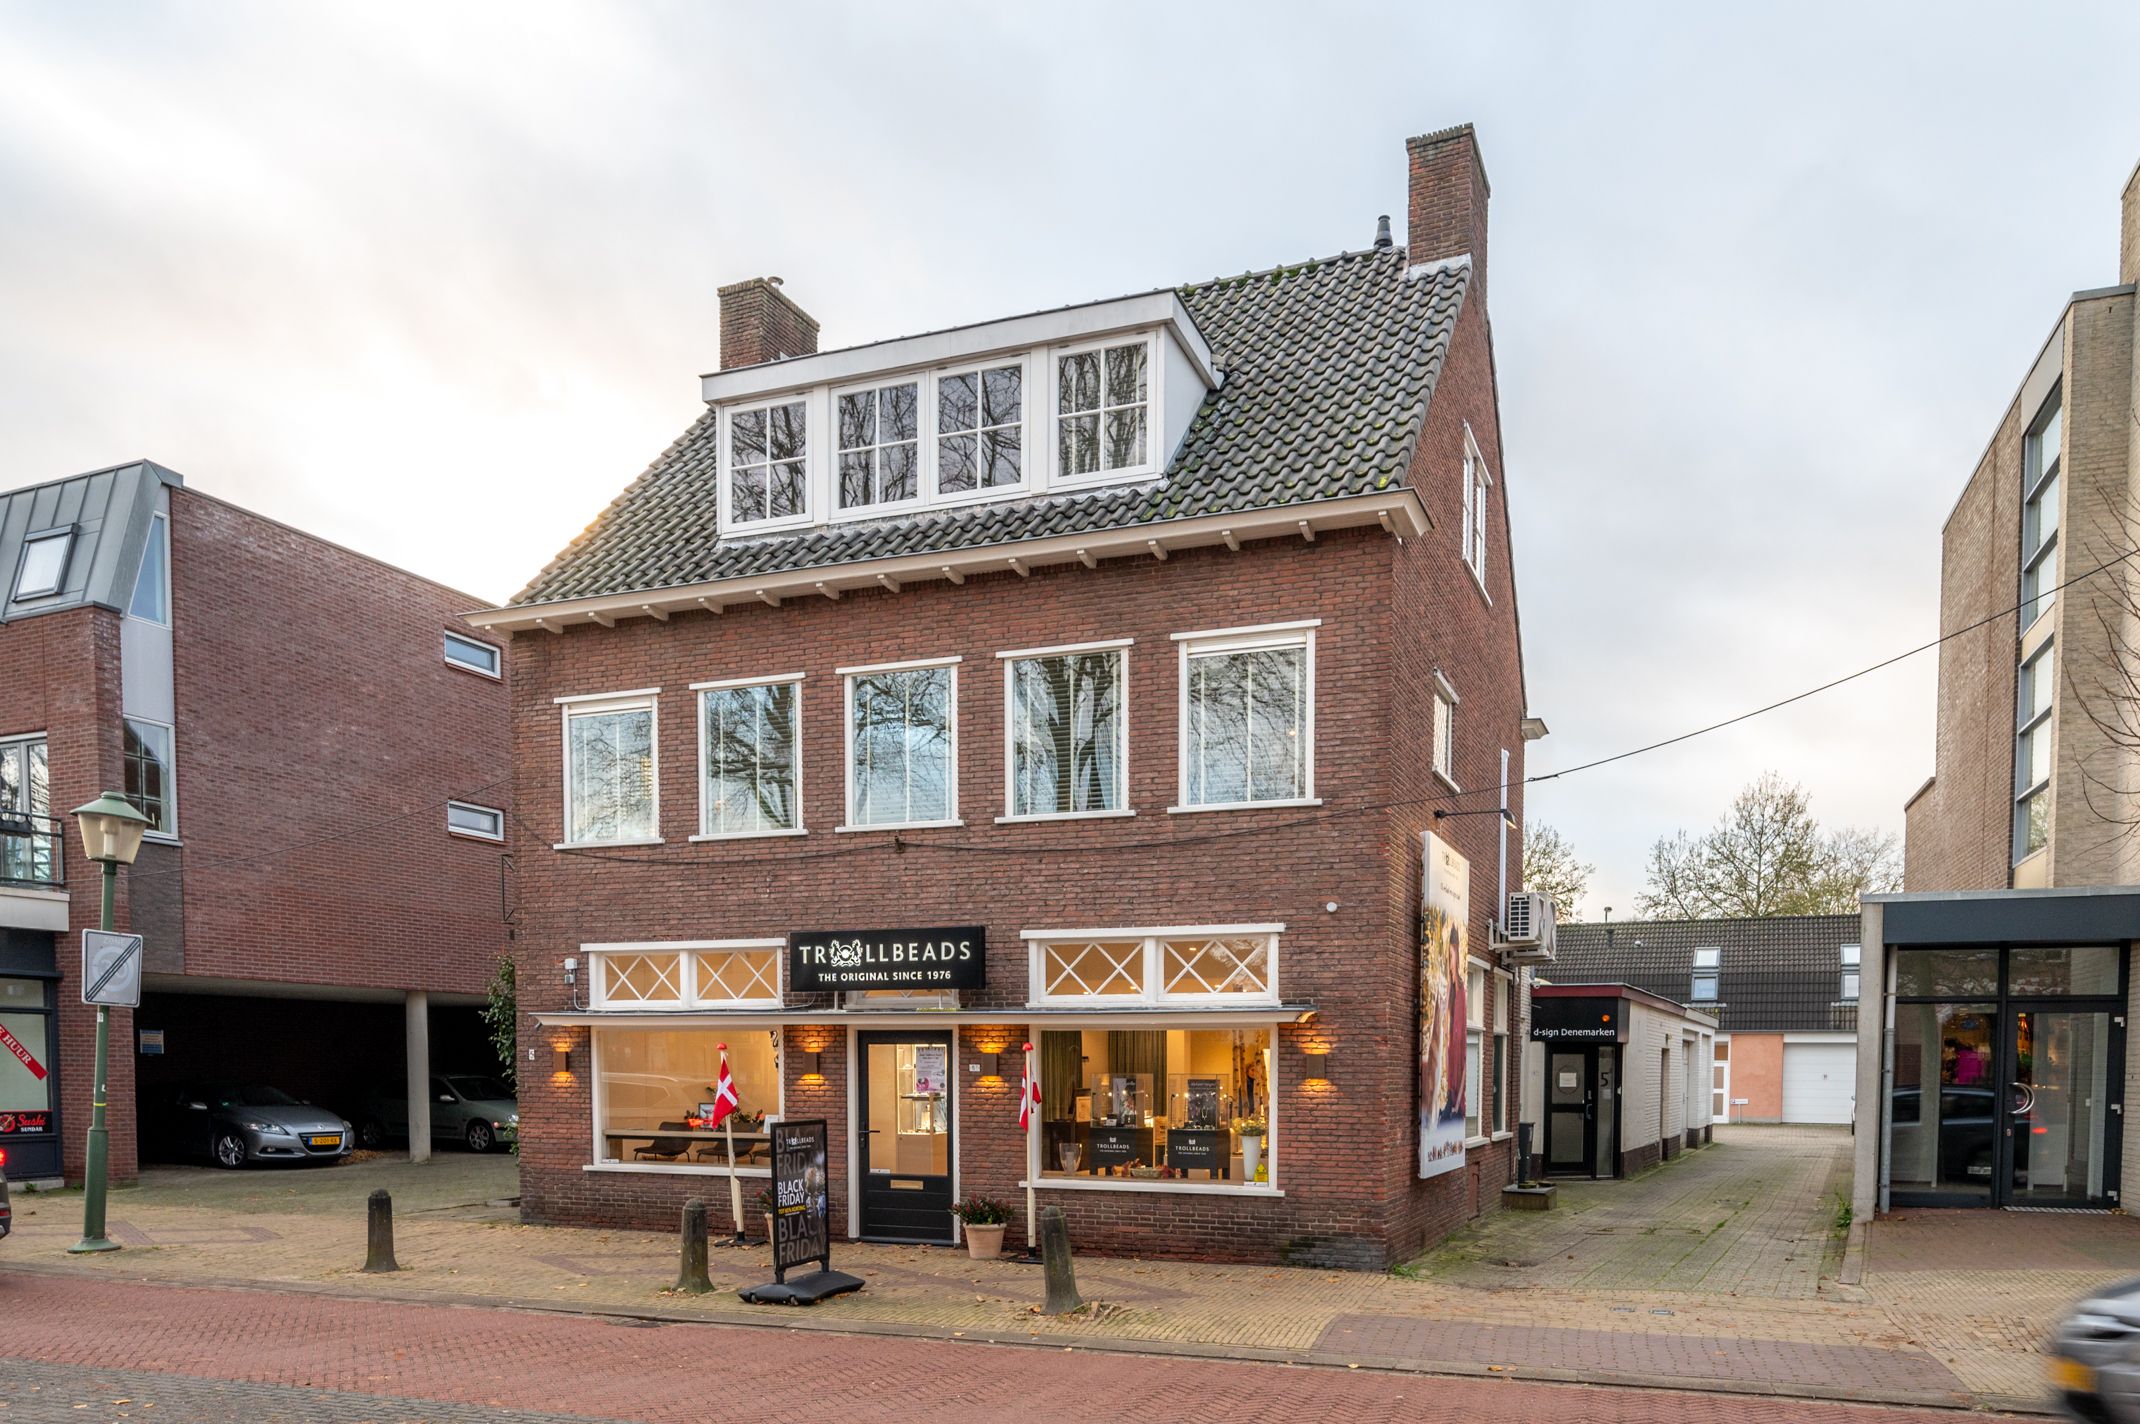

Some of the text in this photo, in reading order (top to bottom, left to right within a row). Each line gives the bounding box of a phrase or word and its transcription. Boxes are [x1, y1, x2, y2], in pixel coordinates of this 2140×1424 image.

[818, 970, 951, 982] THE ORIGINAL SINCE 1976
[1533, 1028, 1615, 1037] d-sign Denemarken
[2, 1033, 32, 1064] HUUR
[1600, 1072, 1609, 1087] 5
[17, 1114, 46, 1127] Sushi
[777, 1178, 804, 1195] BLACK
[777, 1191, 804, 1208] FRIDAY
